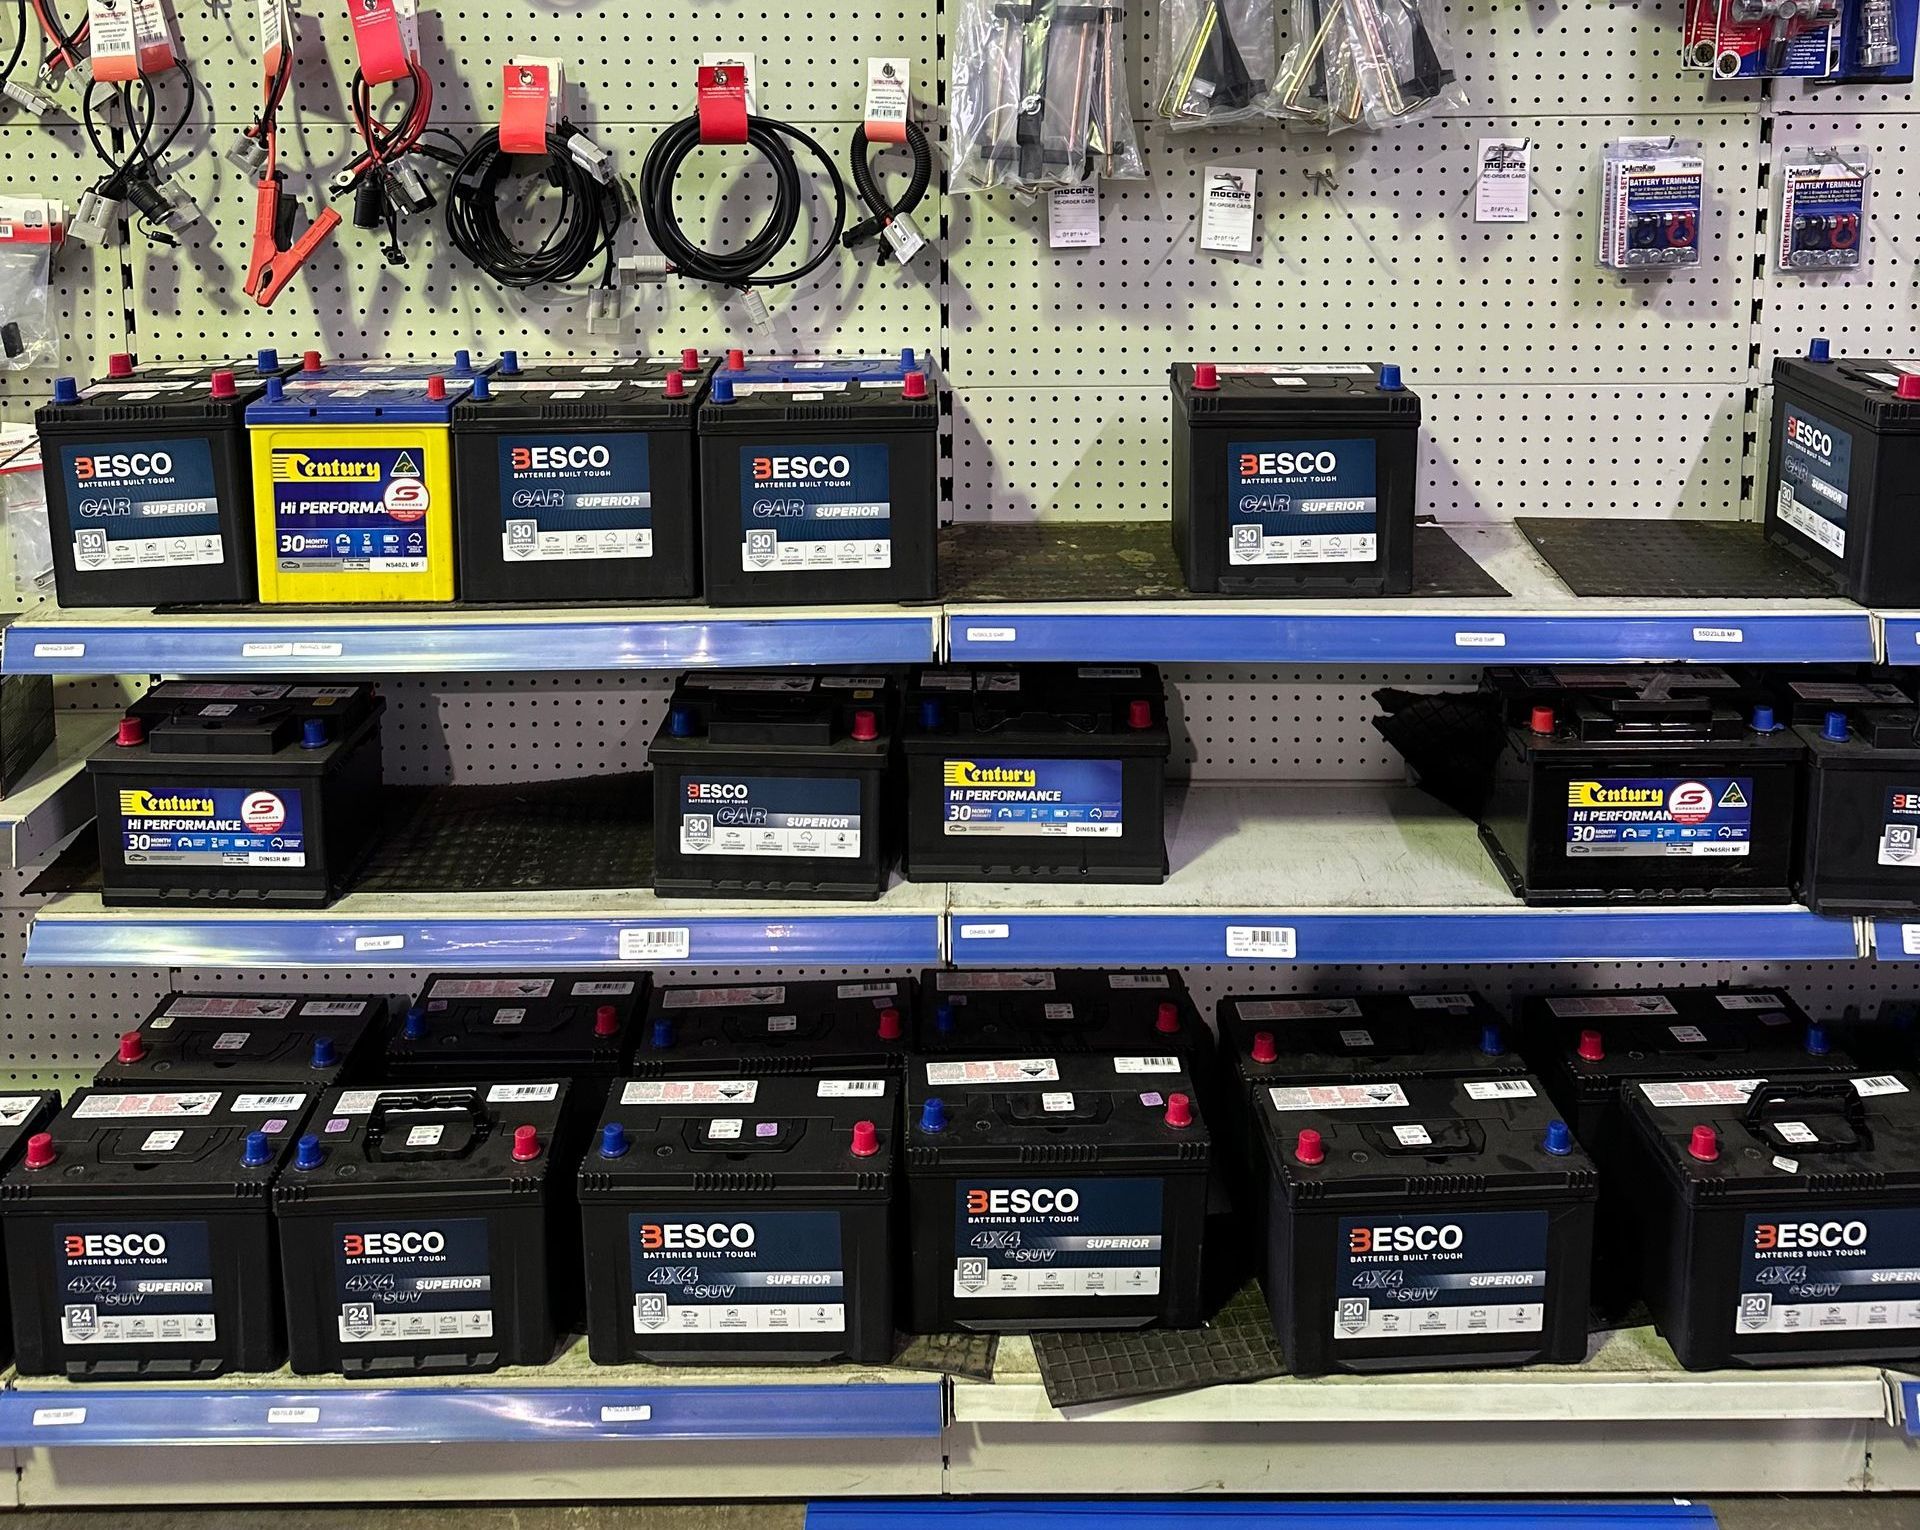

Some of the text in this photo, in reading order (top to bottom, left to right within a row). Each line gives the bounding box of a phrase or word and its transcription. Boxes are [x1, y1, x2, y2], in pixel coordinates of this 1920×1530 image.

[1662, 176, 1699, 185] TERMINALS
[1787, 416, 1832, 457] BESCO
[511, 445, 610, 470] BESCO
[1240, 451, 1336, 476] BESCO
[75, 452, 172, 480] BESCO
[272, 453, 380, 482] Century
[752, 455, 850, 480] BESCO
[513, 468, 611, 479] BATTERIES BUILT TOUGH
[1241, 476, 1283, 484] BATTERIES
[1785, 455, 1842, 504] CAR SUPERIOR
[78, 480, 118, 489] BATTERIES
[754, 479, 851, 489] BATTERIES BUILT TOUGH
[512, 488, 640, 508] CAR SUPERIOR
[1781, 487, 1791, 502] 30
[80, 498, 207, 518] CAR SUPERIOR
[280, 501, 389, 514] Hi PERFORMA
[752, 498, 879, 518] CAR SUPERIOR
[1239, 494, 1365, 513] CAR SUPERIOR
[512, 524, 532, 537] 30
[1238, 529, 1257, 543] 30
[82, 534, 101, 548] 30
[280, 535, 305, 552] 30
[752, 534, 770, 547] 30
[944, 761, 1036, 787] Century
[687, 783, 748, 799] BESCO
[950, 790, 1062, 802] Hi PERFORMANCE
[1568, 782, 1663, 807] Century
[120, 790, 214, 816] Century
[1893, 794, 1920, 808] BE
[717, 807, 849, 828] CAR SUPERIOR
[949, 805, 971, 821] 30
[1573, 811, 1675, 821] Hi PERFORMAN
[127, 819, 242, 831] Hi PERFORMANCE
[689, 819, 707, 832] 30
[1572, 827, 1595, 841] 30
[1891, 830, 1910, 842] 30
[127, 835, 150, 850] 30
[967, 1188, 1079, 1214] BESCO
[641, 1223, 755, 1249] BESCO
[1350, 1224, 1463, 1253] BESCO
[1755, 1221, 1867, 1249] BESCO
[64, 1233, 166, 1257] BESCO
[344, 1231, 445, 1256] BESCO
[1086, 1239, 1150, 1249] SUPERIOR
[962, 1262, 982, 1275] 20
[416, 1279, 482, 1290] SUPERIOR
[766, 1275, 831, 1284] SUPERIOR
[1470, 1275, 1533, 1286] SUPERIOR
[138, 1282, 204, 1292] SUPERIOR
[642, 1299, 661, 1312] 20
[1344, 1303, 1363, 1316] 20
[1747, 1298, 1766, 1311] 20
[71, 1309, 92, 1323] 24
[349, 1307, 368, 1320] 24
